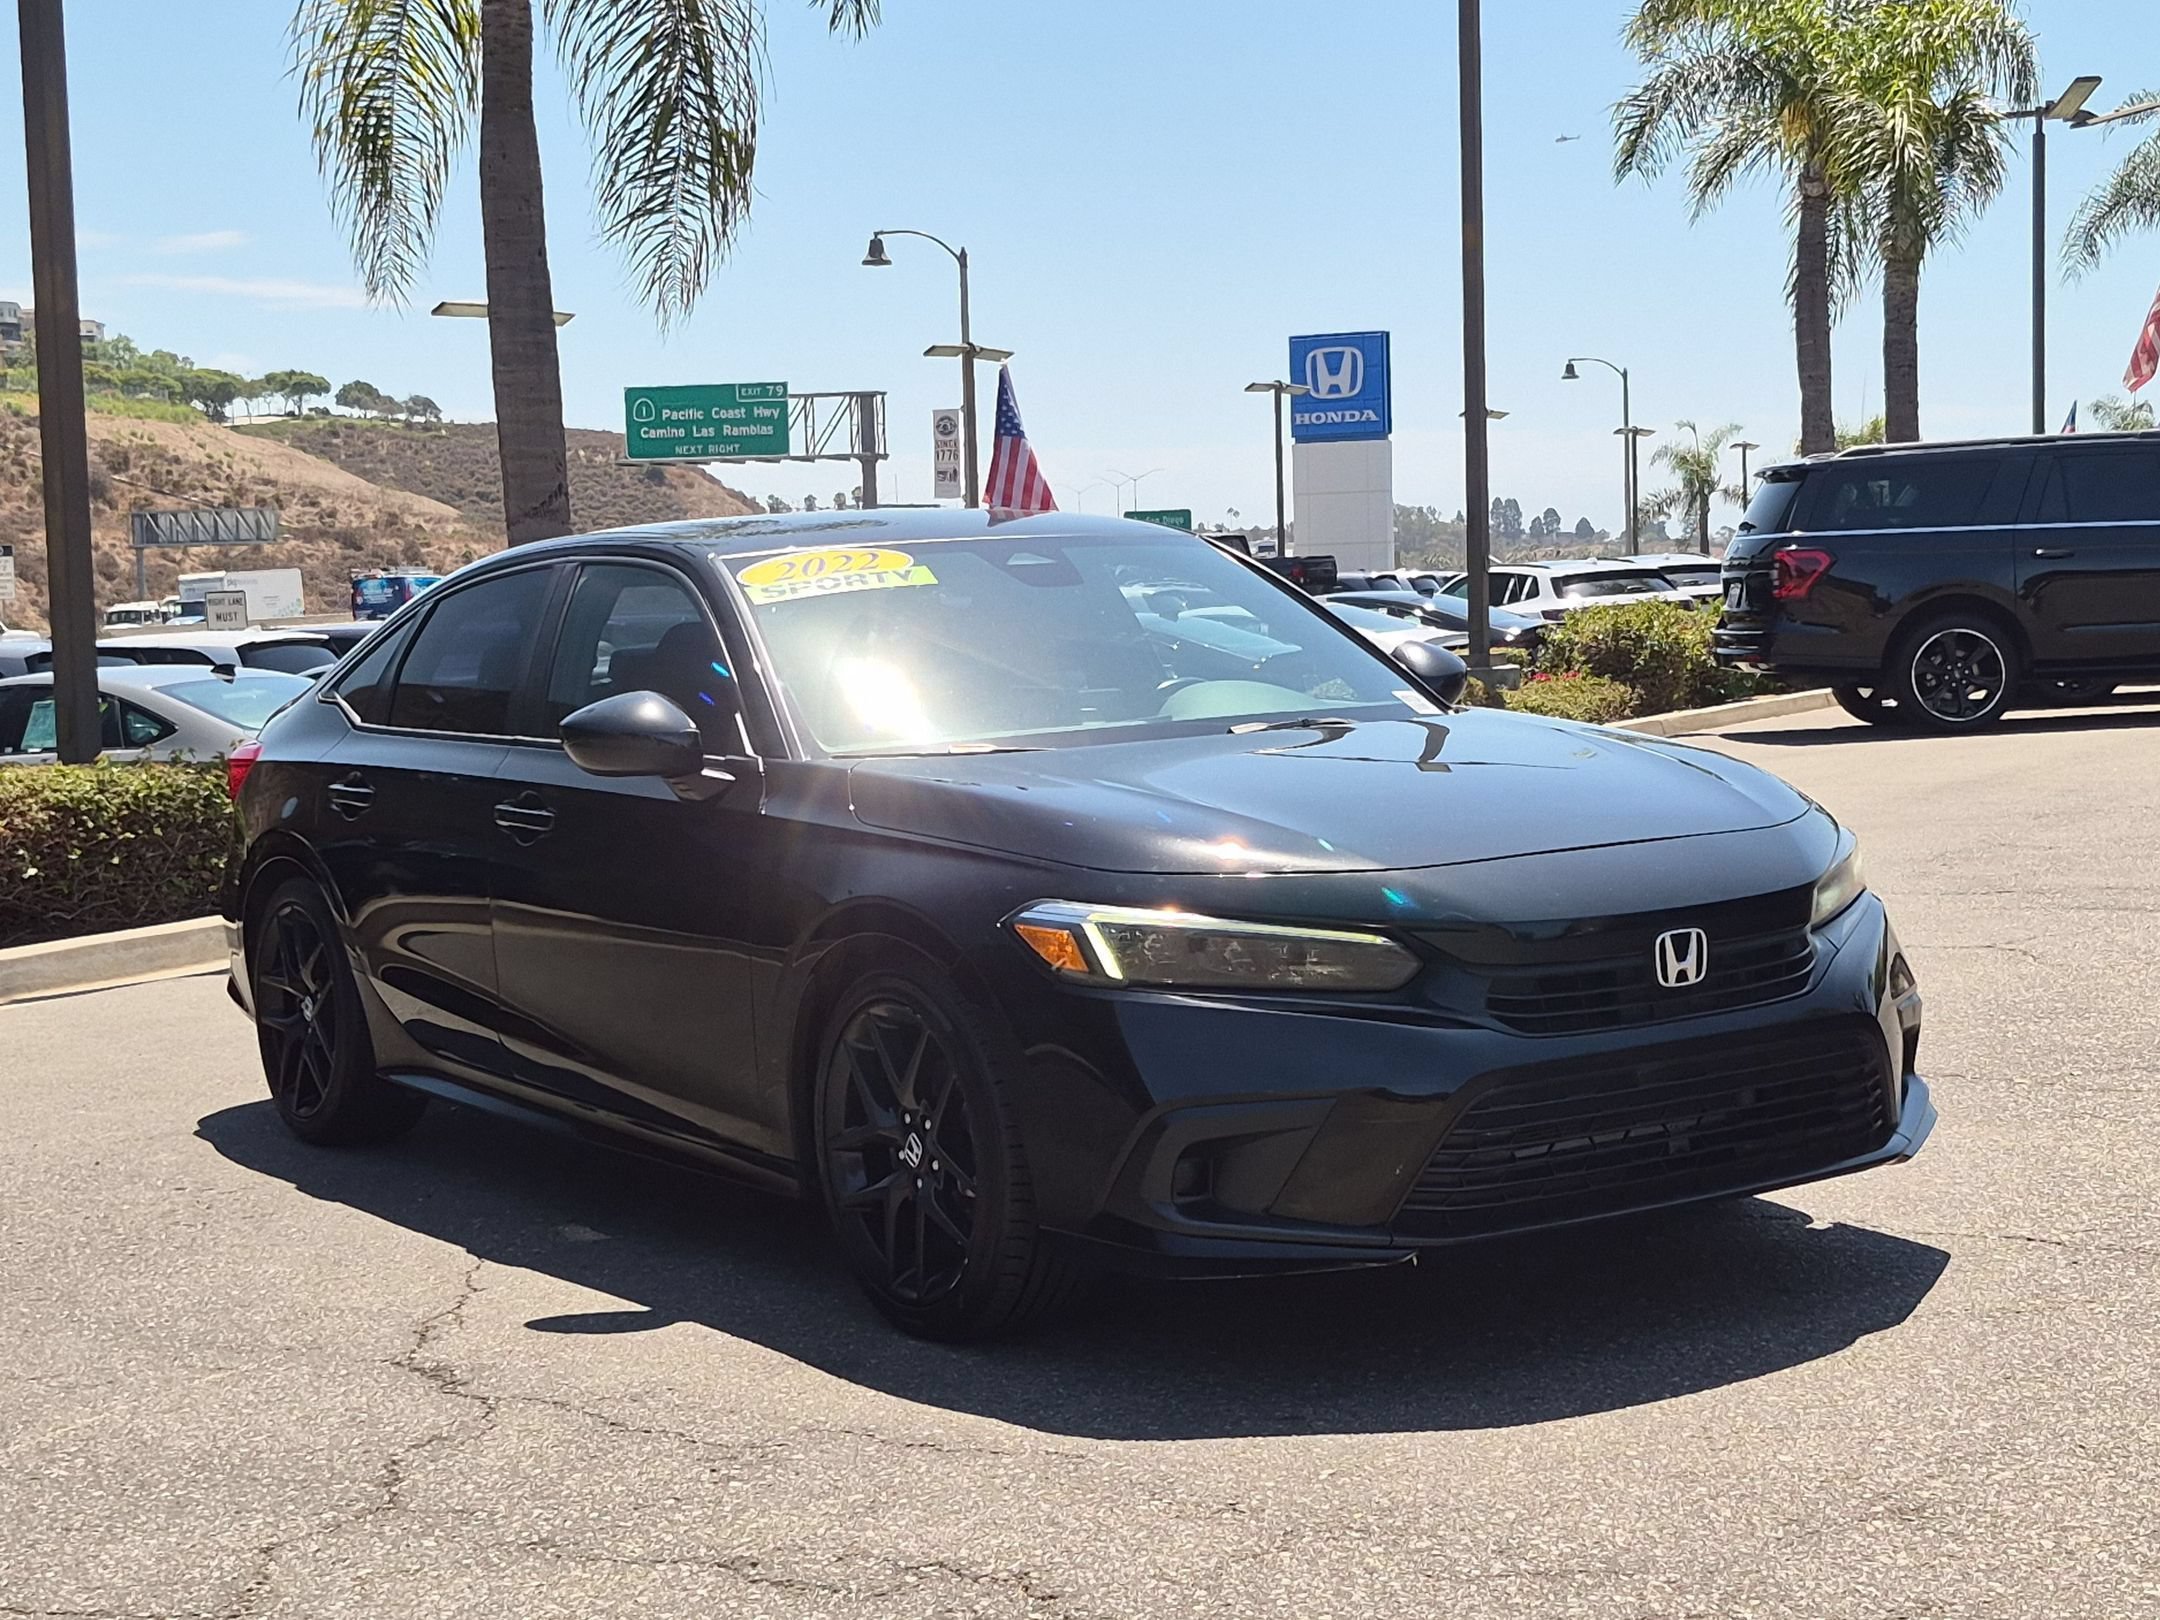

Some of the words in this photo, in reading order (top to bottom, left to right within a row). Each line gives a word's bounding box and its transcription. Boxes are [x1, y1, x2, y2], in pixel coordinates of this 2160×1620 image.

[741, 387, 761, 396] EXIT
[766, 385, 784, 397] 79
[662, 408, 704, 421] Pacific
[711, 407, 746, 419] Coast
[753, 406, 780, 420] Hwy
[1295, 409, 1380, 425] HONDA
[640, 427, 685, 439] Camino
[693, 425, 715, 437] Las
[723, 424, 774, 436] Ramblas
[675, 445, 704, 455] NEXT
[708, 443, 740, 454] RIGHT
[936, 449, 959, 461] 1776
[773, 552, 880, 582] 2022
[216, 611, 238, 622] MUST
